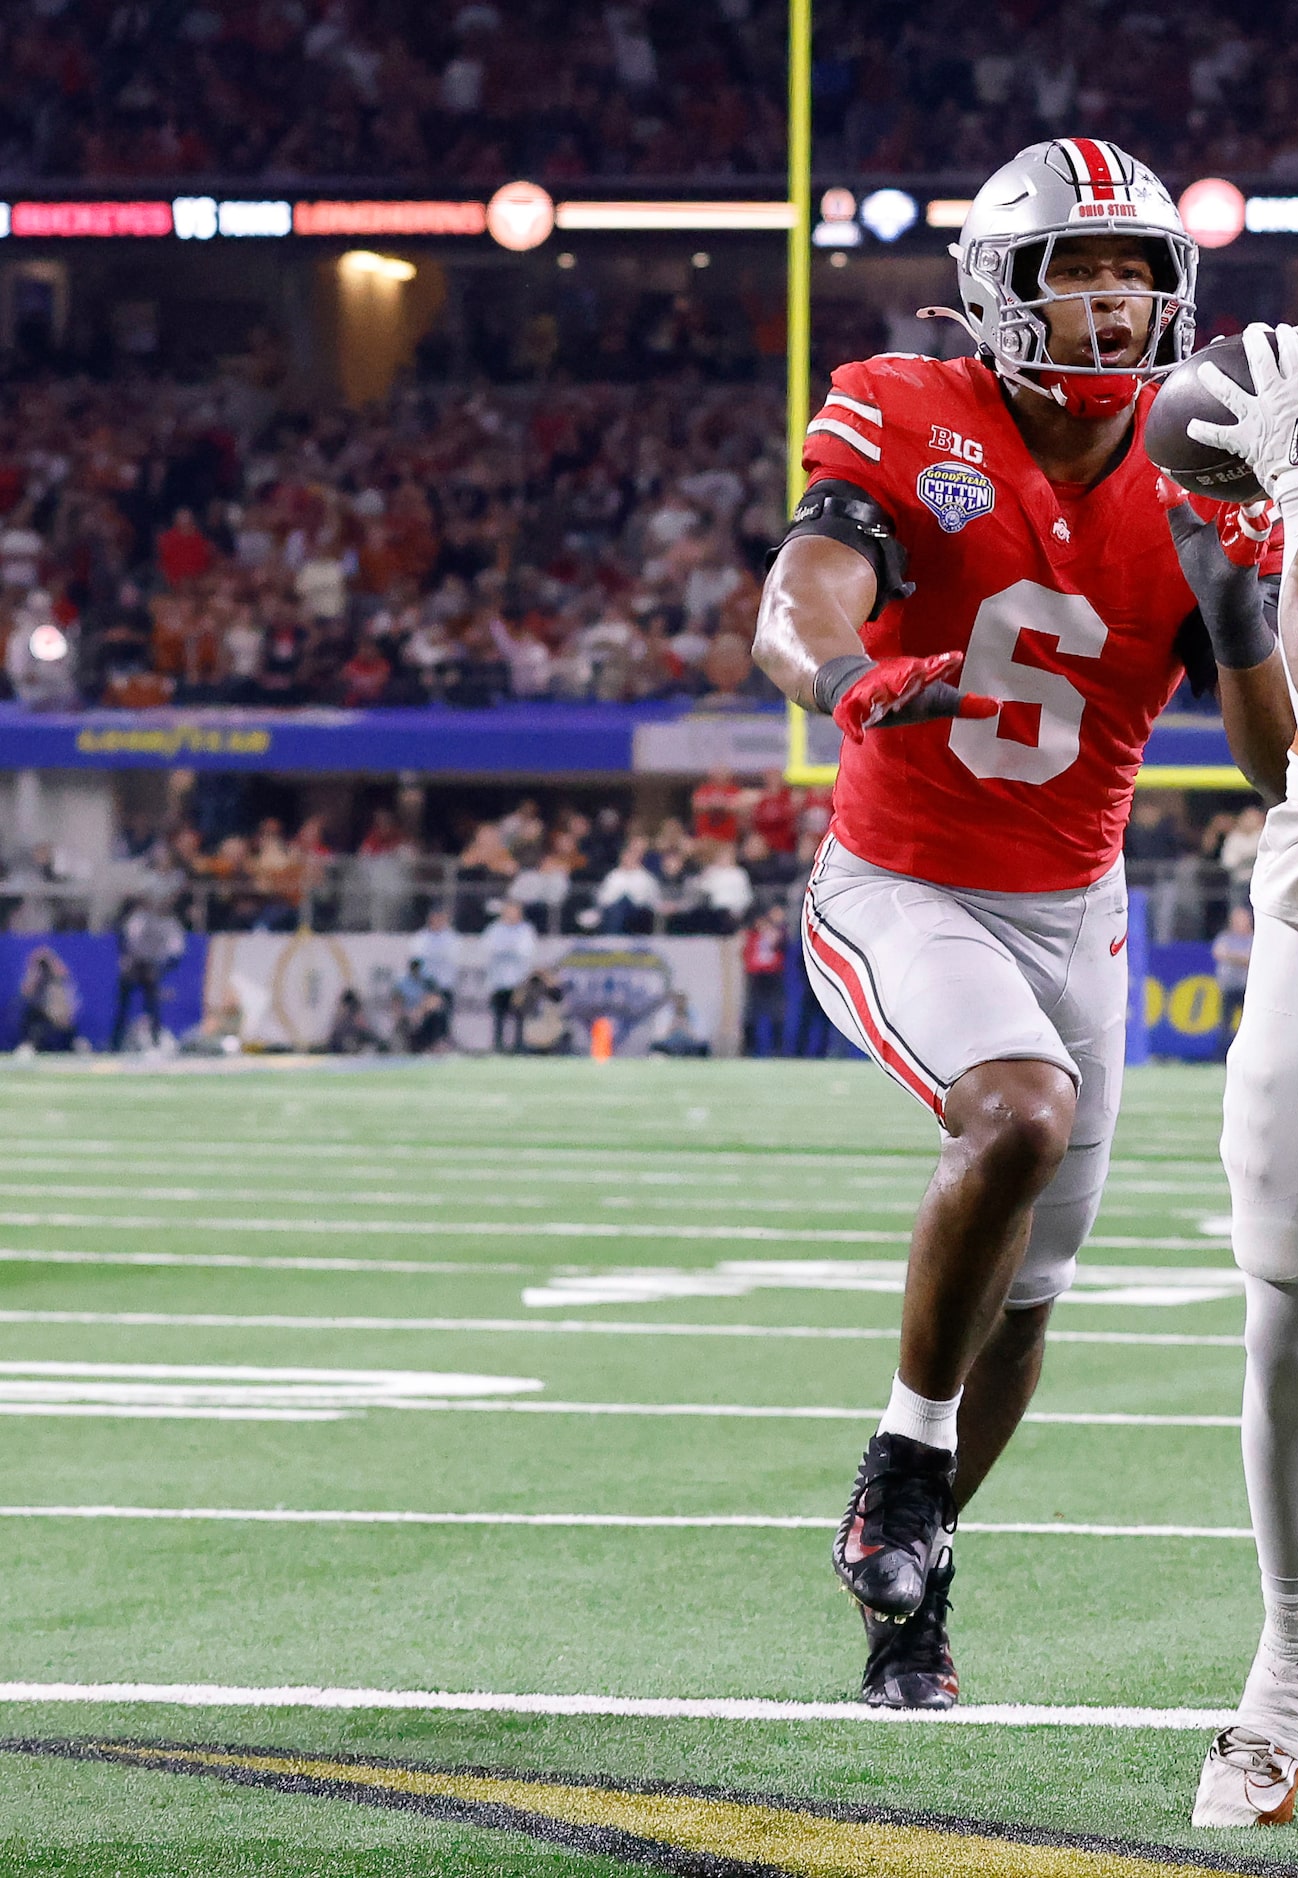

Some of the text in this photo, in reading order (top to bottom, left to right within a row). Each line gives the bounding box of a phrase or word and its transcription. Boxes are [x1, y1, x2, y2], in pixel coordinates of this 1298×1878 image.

[1078, 203, 1138, 217] OHIO STATE
[926, 469, 987, 486] GOODYEAR
[924, 478, 988, 507] COTTON
[935, 492, 977, 511] BOWL
[948, 578, 1109, 785] 6
